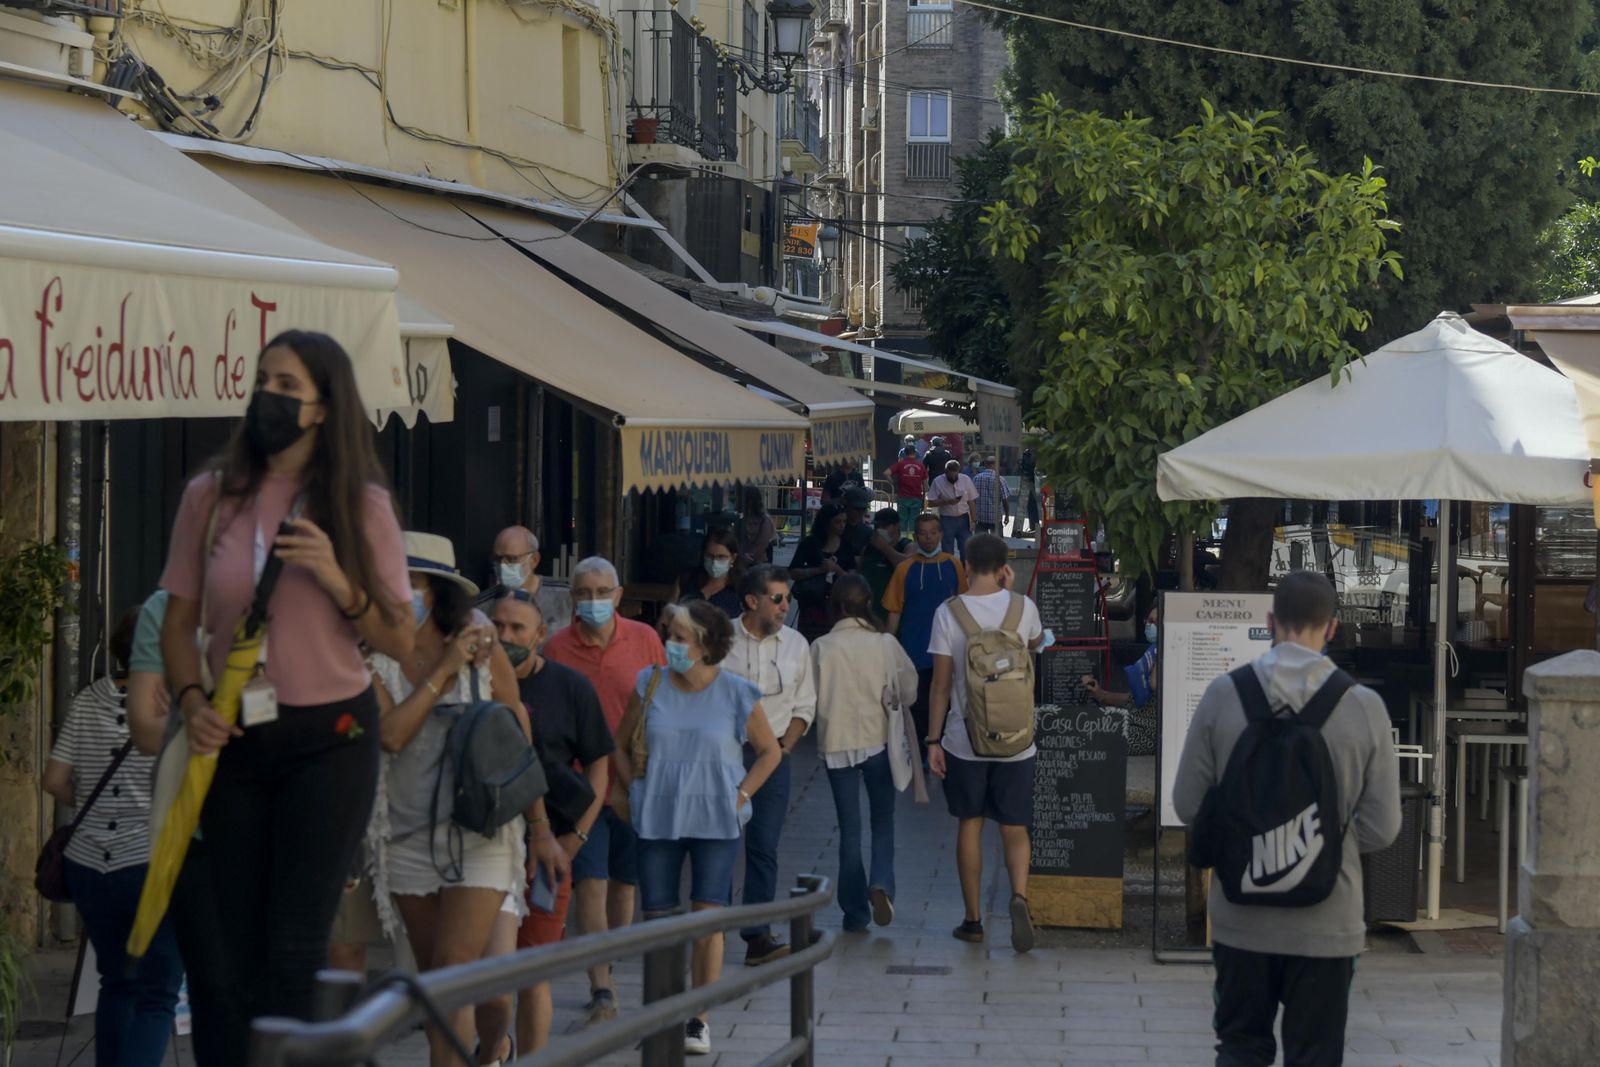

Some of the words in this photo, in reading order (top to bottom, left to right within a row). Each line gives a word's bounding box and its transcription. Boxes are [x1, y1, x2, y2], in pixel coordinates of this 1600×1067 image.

[35, 276, 198, 404] freiduría
[214, 308, 246, 400] de
[640, 430, 732, 480] MARISQUERIA
[1047, 527, 1078, 535] Comidas
[1202, 599, 1246, 609] MENU
[1195, 610, 1253, 620] CASERO
[1041, 712, 1073, 734] Casa
[1075, 712, 1120, 741] Cepillo
[1078, 750, 1107, 761] PESCADO
[1252, 802, 1323, 880] NIKE
